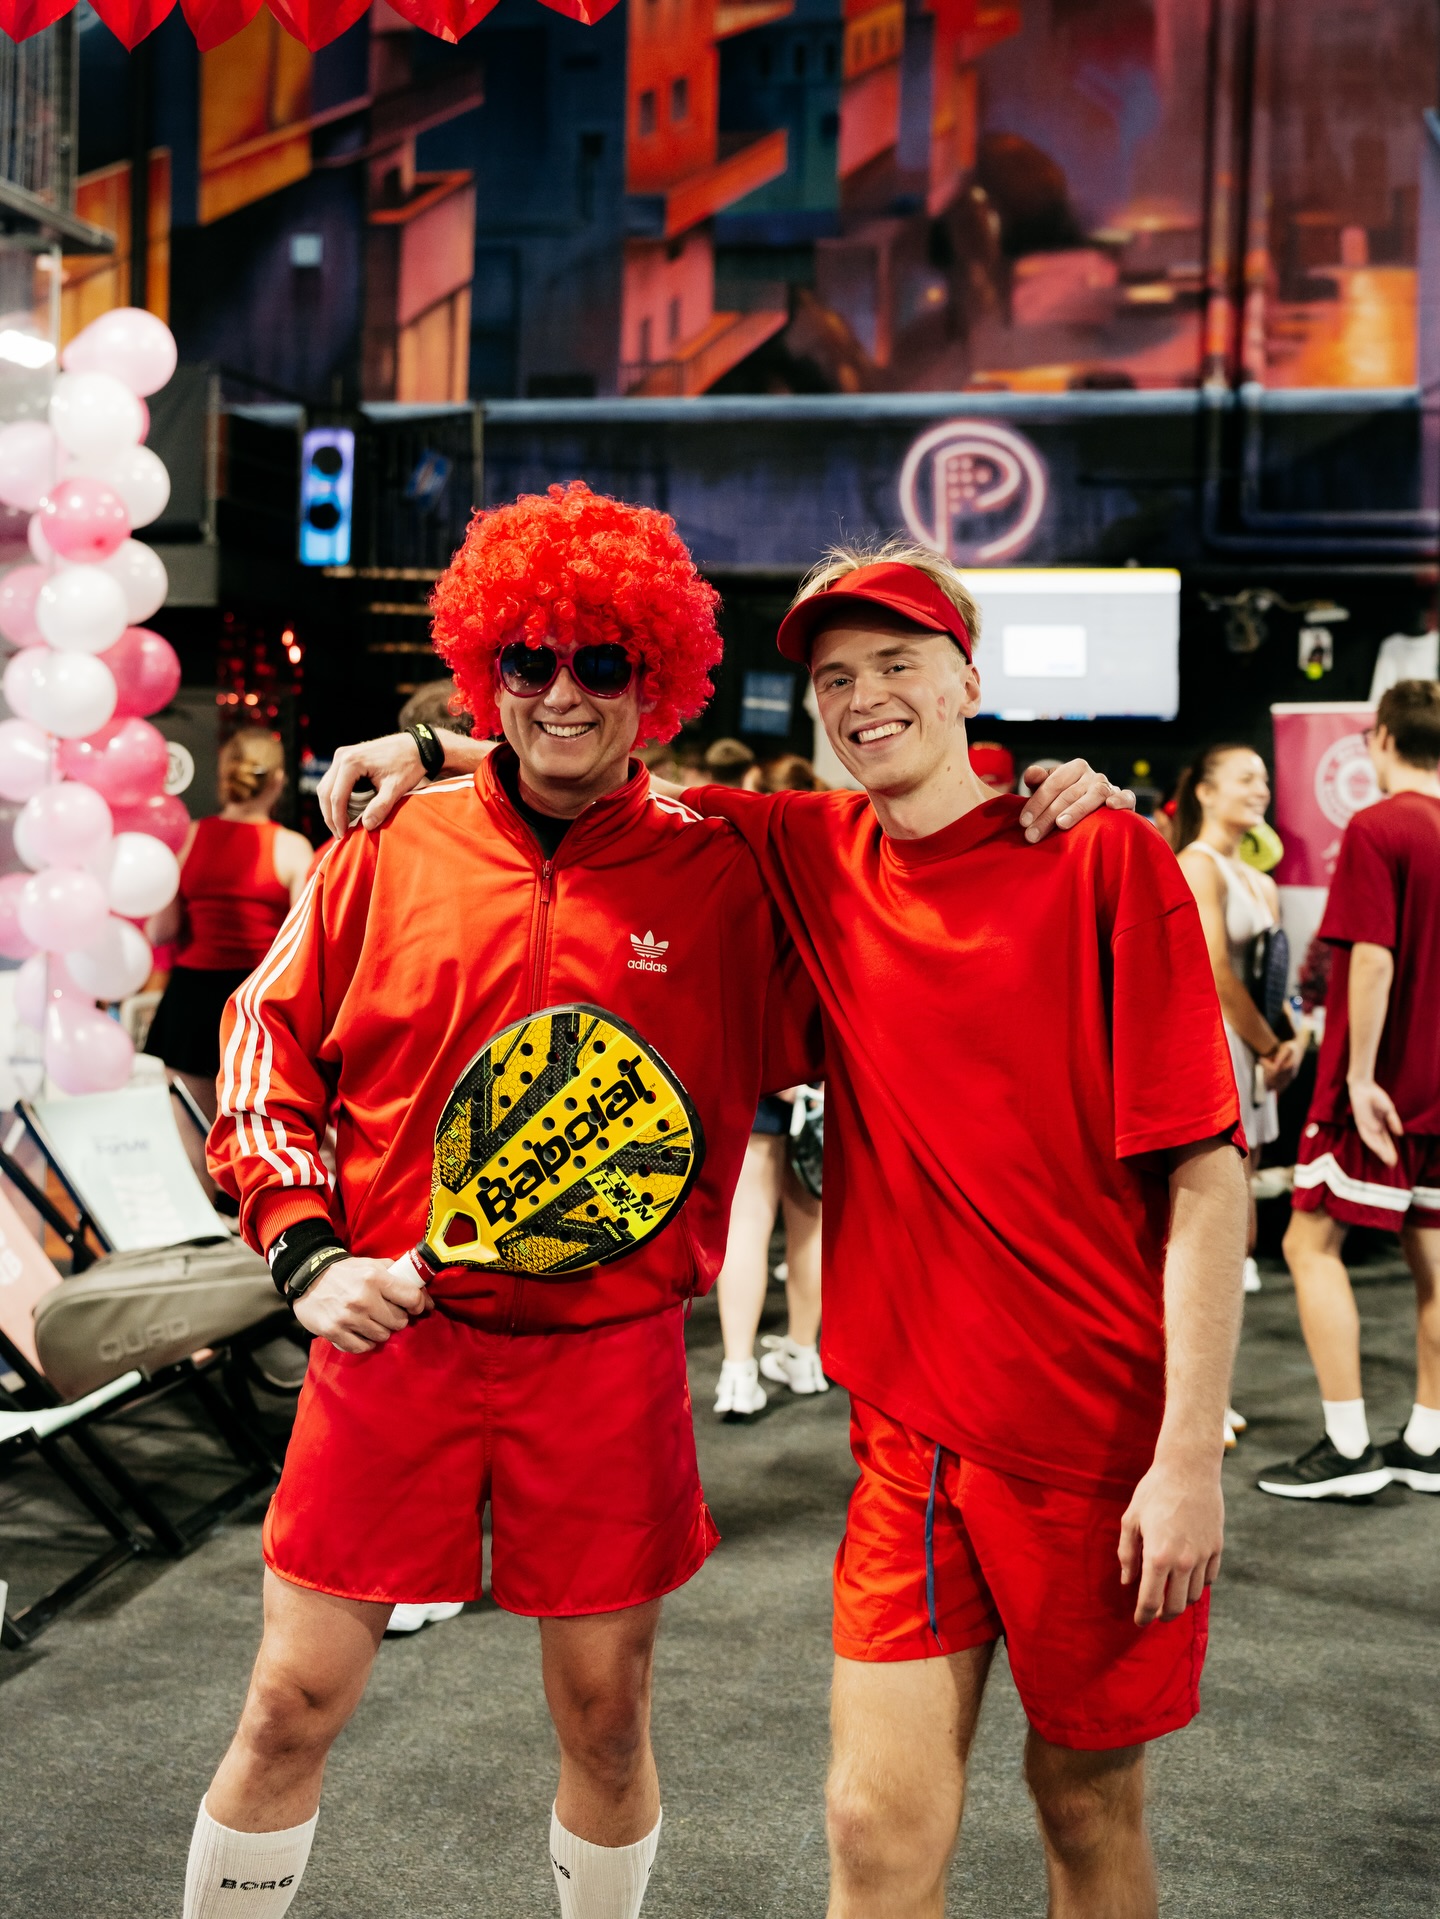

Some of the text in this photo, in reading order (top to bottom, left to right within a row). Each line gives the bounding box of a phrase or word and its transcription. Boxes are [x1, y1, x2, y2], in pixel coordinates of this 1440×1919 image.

[627, 959, 668, 973] adidas
[476, 1055, 647, 1227] Babolat
[220, 1874, 295, 1891] BORG
